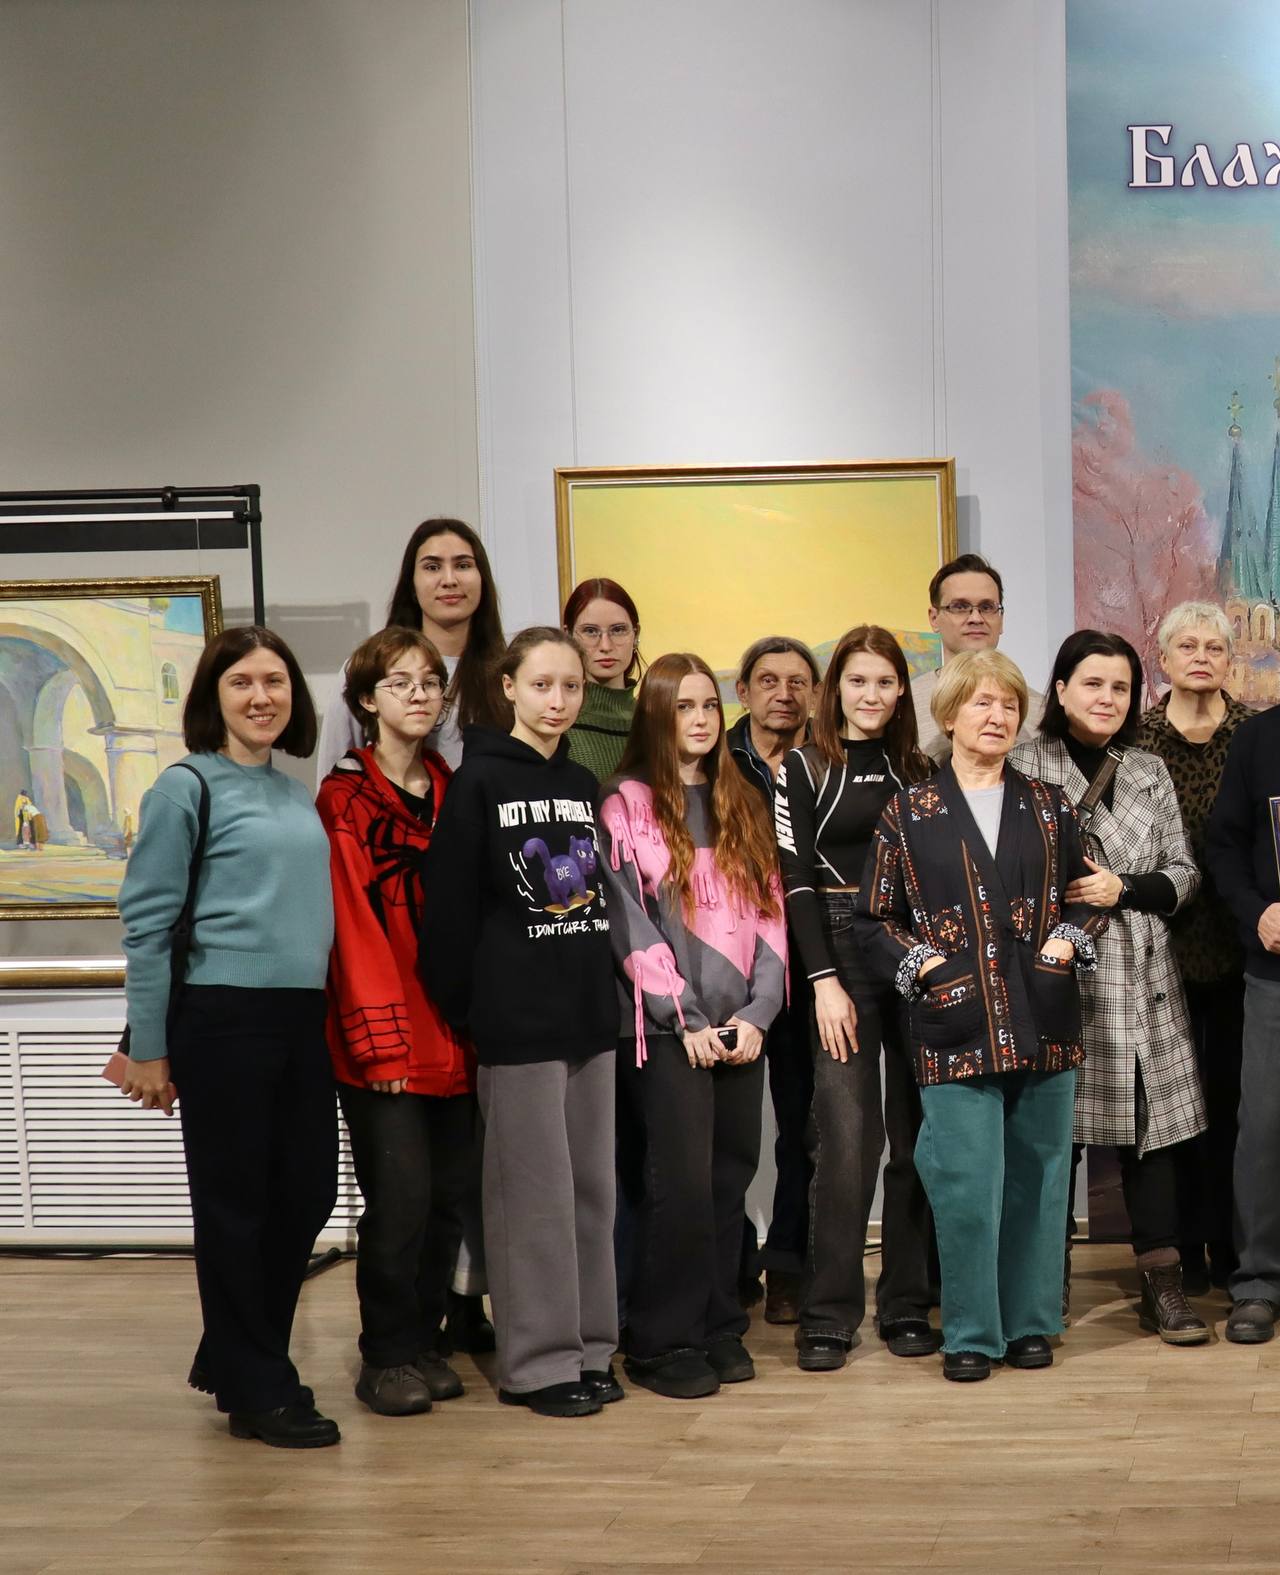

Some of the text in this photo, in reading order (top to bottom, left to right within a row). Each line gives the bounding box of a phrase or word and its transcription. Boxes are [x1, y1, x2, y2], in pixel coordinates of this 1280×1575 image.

[498, 801, 526, 828] NOT
[529, 799, 551, 823] MY
[527, 926, 534, 938] I
